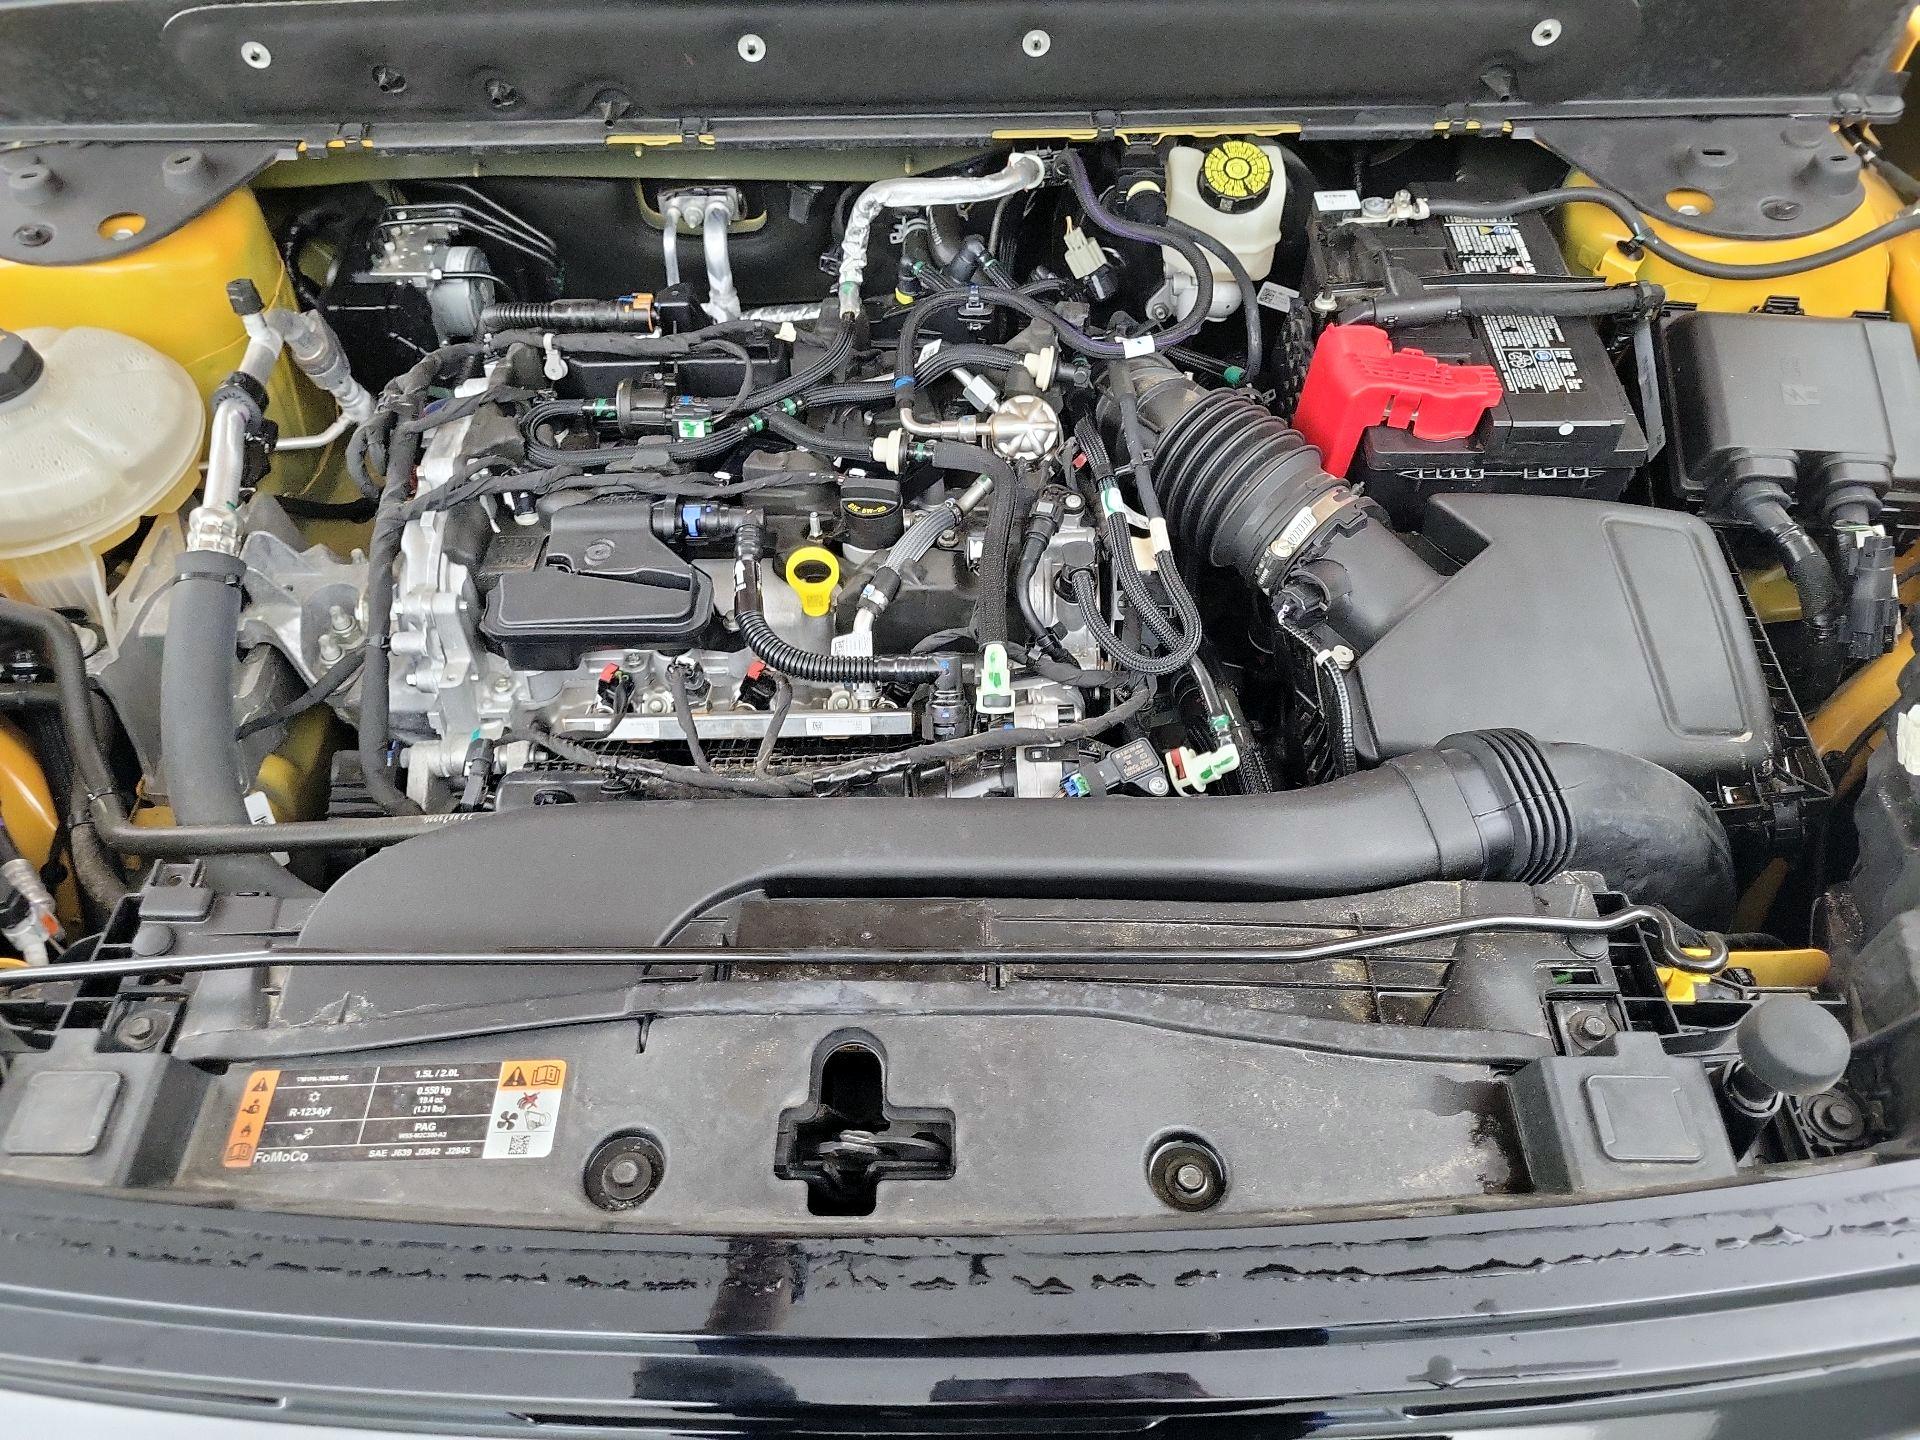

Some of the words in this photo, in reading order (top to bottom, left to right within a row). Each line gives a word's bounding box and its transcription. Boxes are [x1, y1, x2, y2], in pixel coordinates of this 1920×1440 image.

[415, 1069, 434, 1078] 1.5L
[441, 1068, 460, 1077] 2.0L
[416, 1086, 440, 1096] 0.550
[440, 1085, 452, 1097] kg
[288, 1106, 333, 1118] R-1234yf
[414, 1122, 437, 1132] PAG
[253, 1150, 309, 1163] FoMoCo
[368, 1149, 388, 1158] SAE
[391, 1148, 412, 1157] J639
